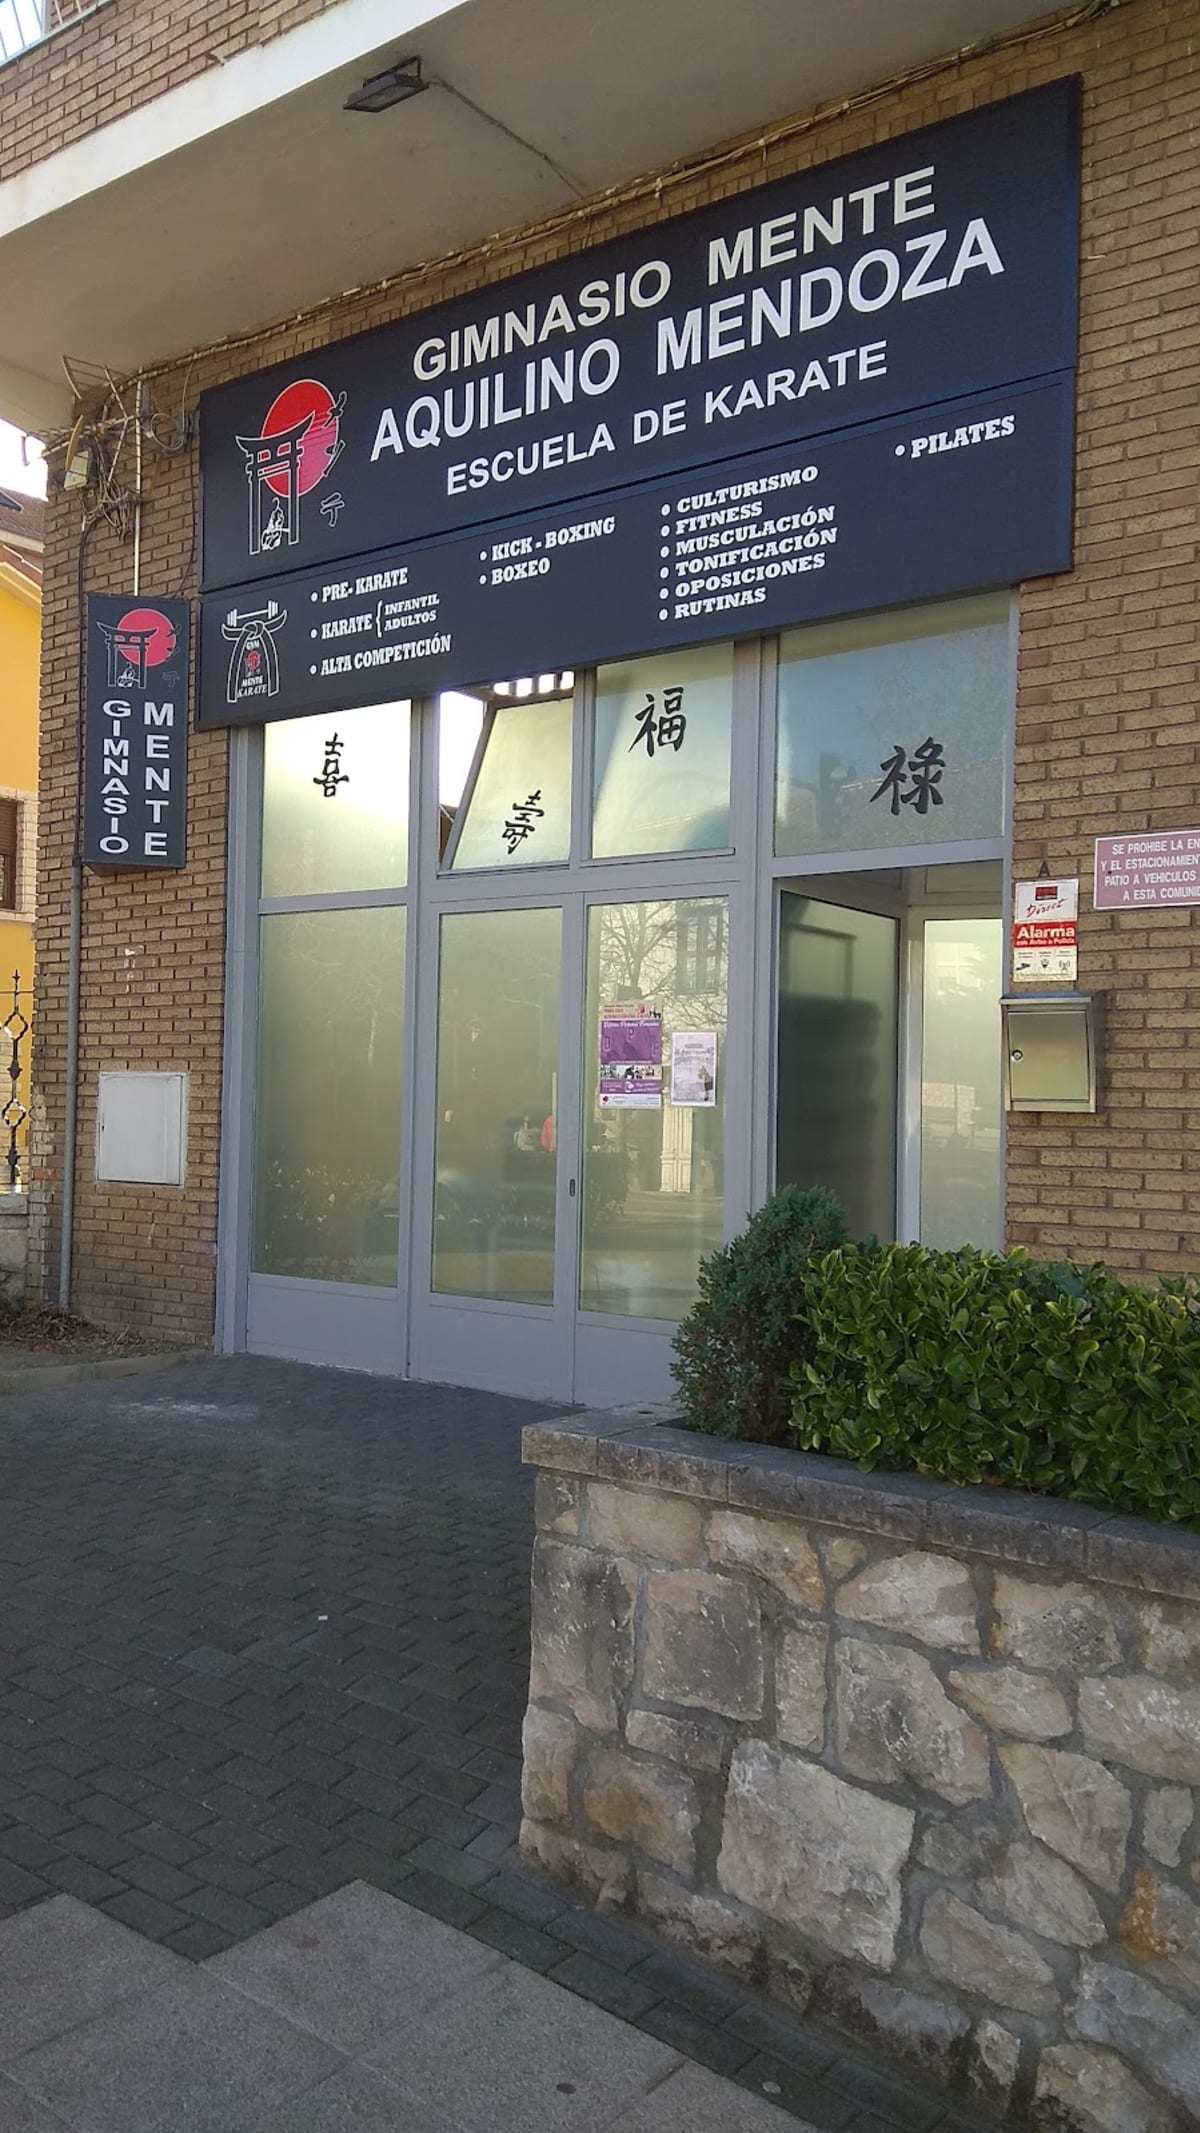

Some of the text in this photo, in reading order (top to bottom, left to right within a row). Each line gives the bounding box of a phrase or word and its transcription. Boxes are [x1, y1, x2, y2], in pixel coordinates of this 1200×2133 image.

[413, 165, 935, 381] GIMNASIO MENTE
[370, 217, 1004, 462] AQUILINO MENDOZA
[447, 340, 887, 495] ESCUELA DE KARATE
[911, 414, 1015, 459] PILATES
[677, 465, 819, 513] CULTURISMO
[675, 501, 763, 535] FITNESS
[675, 505, 836, 556] MUSCULACIÓN
[491, 557, 551, 585] BOXEO
[675, 527, 838, 576] TONIFICACIÓN
[674, 553, 826, 598] OPOSICIONES
[384, 593, 440, 616] INFANTIL
[384, 610, 437, 631] ADULTOS
[674, 587, 767, 619] RUTINAS
[321, 613, 373, 640] KARATE
[320, 632, 452, 676] ALTA COMPETICIÓN
[237, 683, 268, 698] KARATE
[628, 687, 686, 757] 福
[99, 700, 132, 854] GIMNASIO
[143, 702, 174, 856] MENTE
[313, 731, 349, 797] 喜
[1100, 861, 1107, 871] Y
[1110, 860, 1122, 870] EL
[1112, 843, 1125, 855] SE
[1127, 841, 1167, 854] PROHIBE
[1171, 839, 1184, 850] LA
[1104, 870, 1197, 887] PATIO A VEHICULOS
[1122, 890, 1130, 901] A
[1133, 889, 1157, 900] ESTA
[1017, 925, 1075, 939] Alarma
